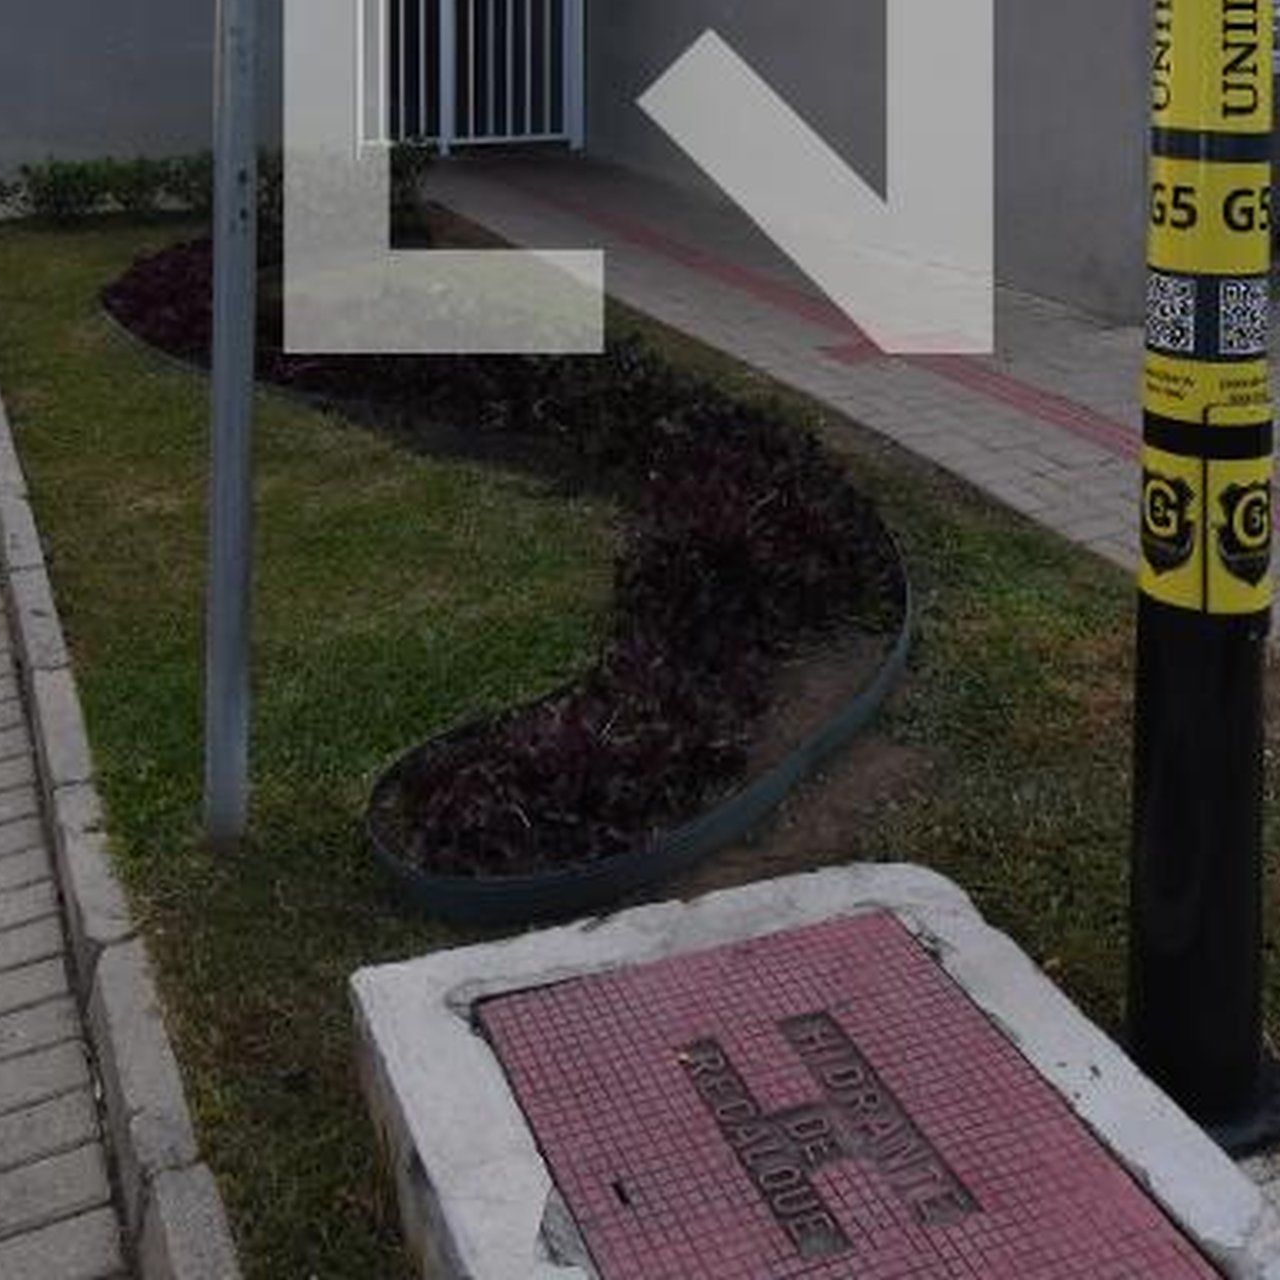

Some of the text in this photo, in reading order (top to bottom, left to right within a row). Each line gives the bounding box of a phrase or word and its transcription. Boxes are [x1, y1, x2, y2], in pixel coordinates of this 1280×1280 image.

[689, 1051, 834, 1236] RECALQUE
[792, 1118, 834, 1165] DE
[796, 1026, 970, 1222] HIDRANTE
